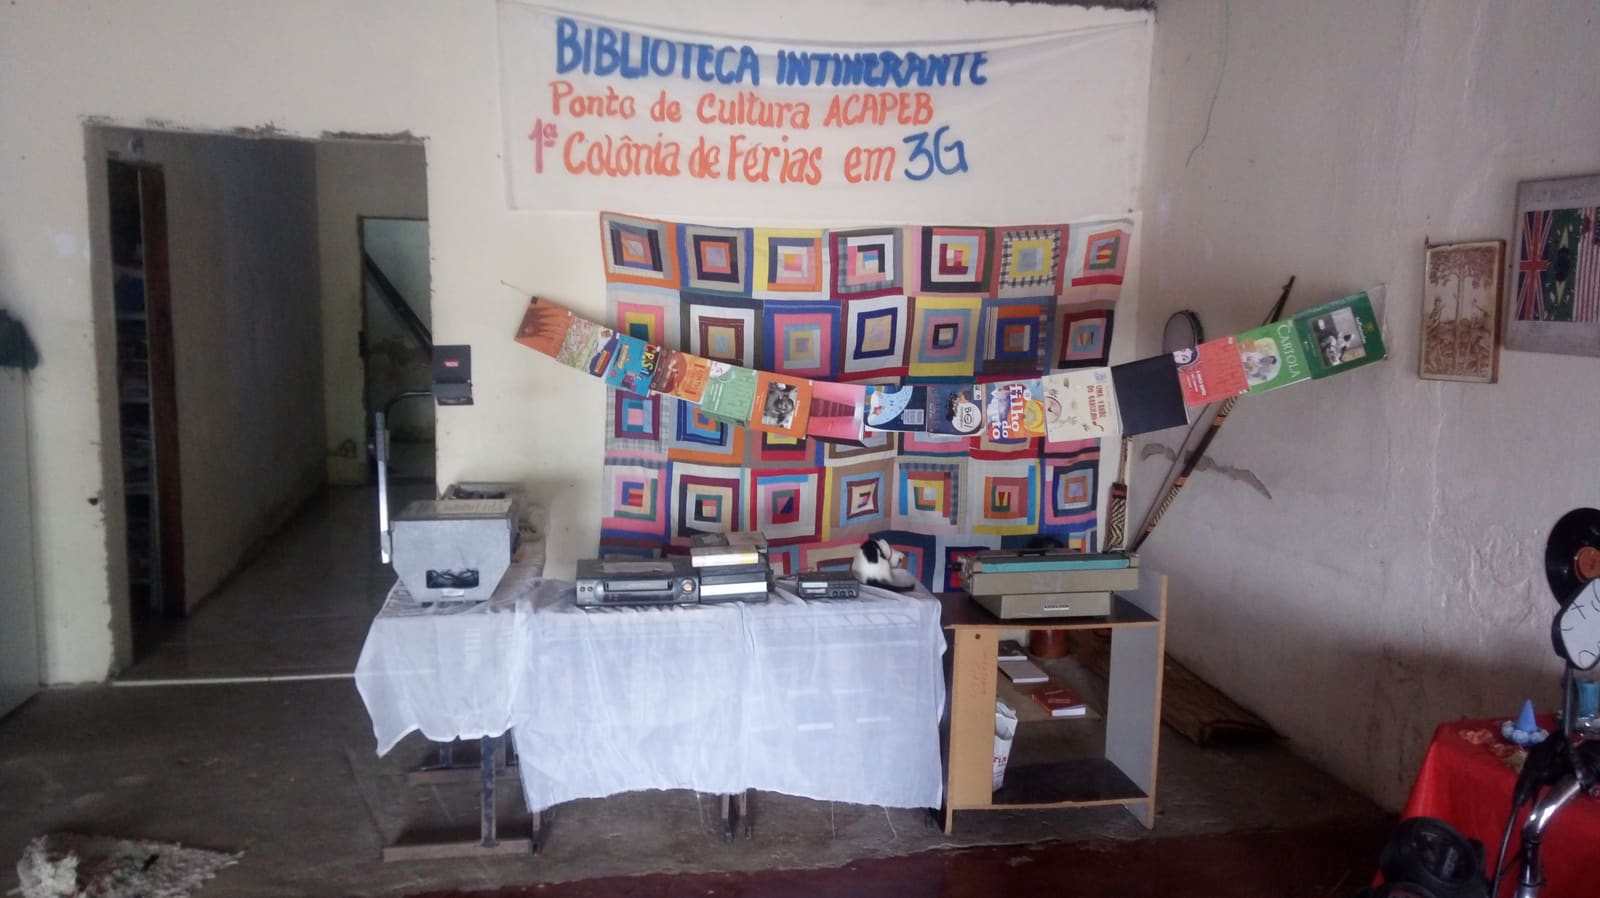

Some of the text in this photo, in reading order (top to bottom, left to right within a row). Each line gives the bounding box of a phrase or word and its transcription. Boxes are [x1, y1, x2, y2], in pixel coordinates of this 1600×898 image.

[556, 17, 988, 87] BIBLIOTECA INTINERANTE
[549, 80, 934, 129] Ponto de Cultura ACAPEB
[563, 132, 681, 177] Colônia
[688, 135, 721, 179] de
[844, 146, 897, 184] em
[903, 126, 969, 181] 3G
[1277, 323, 1301, 378] CARTOLA
[1001, 420, 1010, 438] do
[1010, 384, 1025, 432] filho
